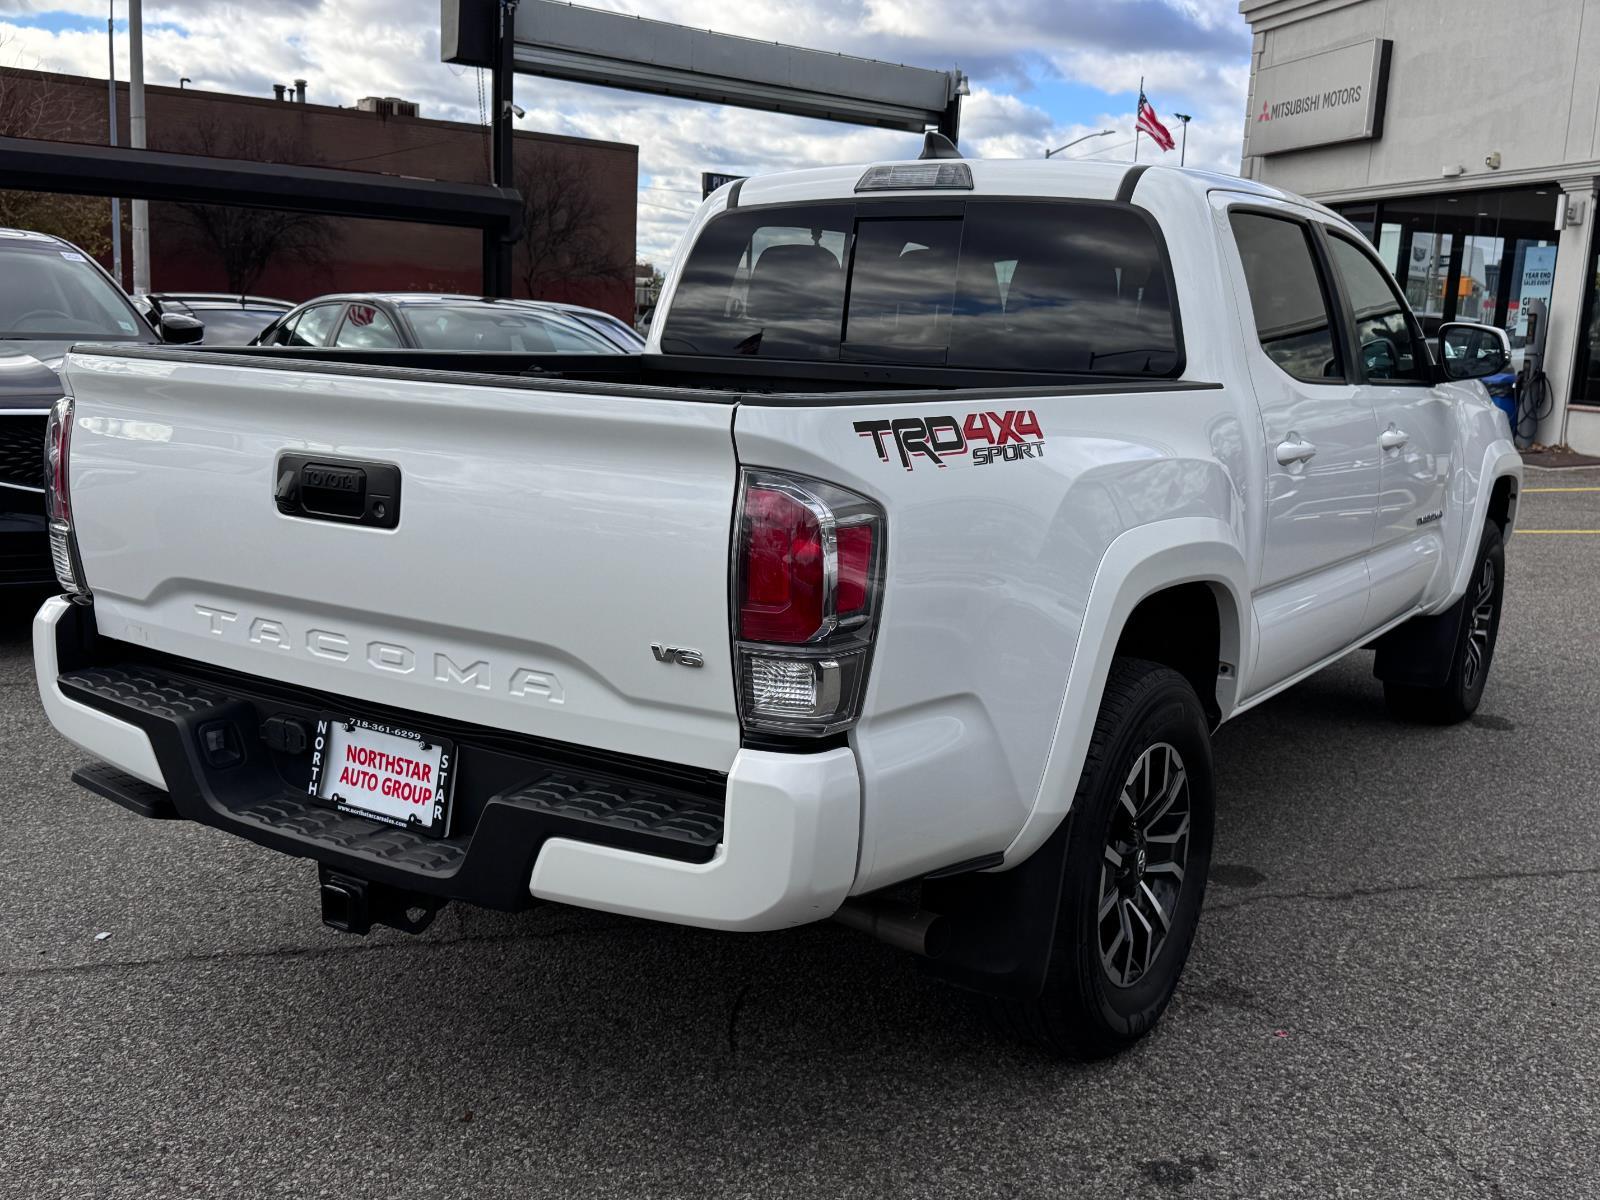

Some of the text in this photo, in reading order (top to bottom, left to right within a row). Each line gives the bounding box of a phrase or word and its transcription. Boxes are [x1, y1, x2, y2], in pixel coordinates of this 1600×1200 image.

[1271, 85, 1362, 120] MITSUBISHI MOTORS
[1525, 271, 1552, 279] YEAR END
[853, 410, 1044, 471] TRD 4X4
[973, 440, 1046, 466] SPORT
[304, 470, 354, 489] TOYOTA
[194, 603, 566, 704] TACOMA
[649, 641, 705, 669] V6
[350, 717, 421, 740] 718-361-6299
[308, 720, 327, 796] NORTH
[346, 744, 432, 783] NORTHSTAR
[339, 766, 432, 806] AUTO GROUP
[433, 755, 449, 820] STAR
